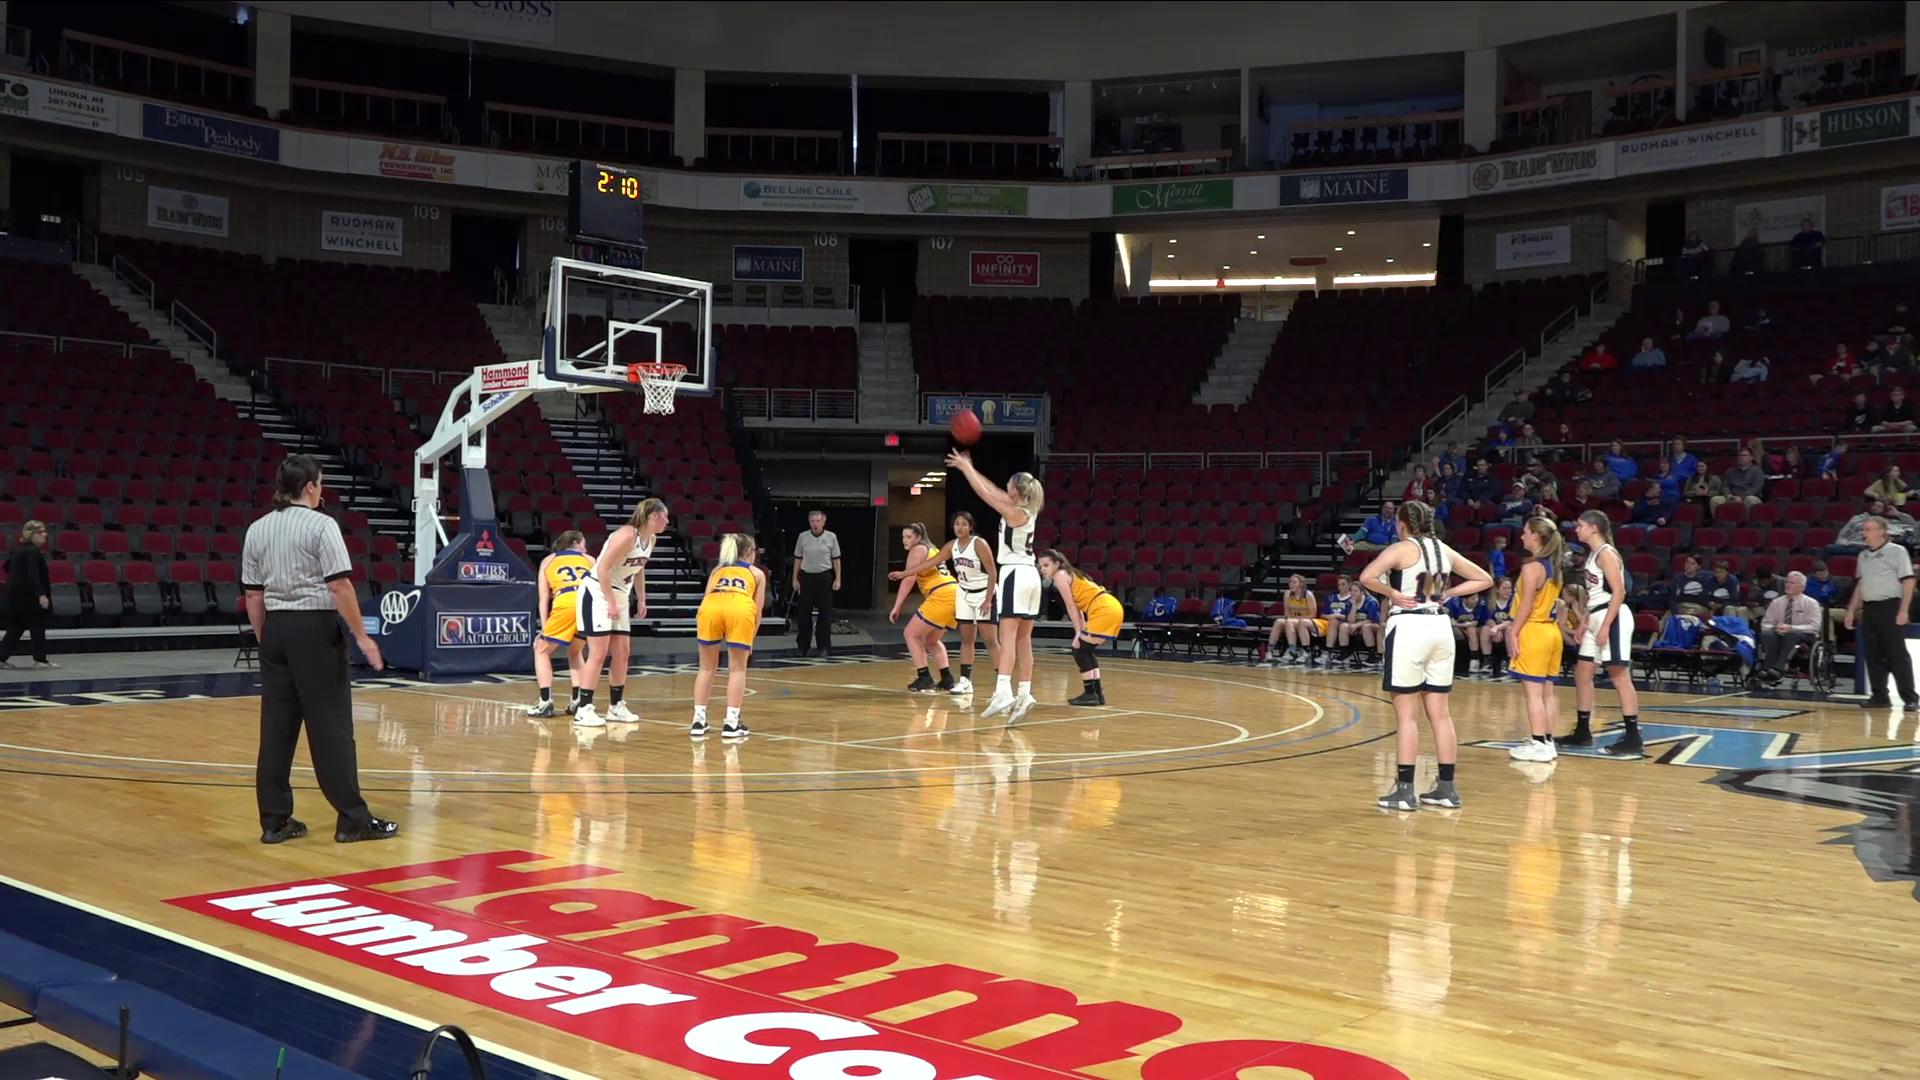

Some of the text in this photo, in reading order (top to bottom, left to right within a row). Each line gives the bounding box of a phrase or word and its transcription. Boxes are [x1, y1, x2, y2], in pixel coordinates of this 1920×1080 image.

[164, 109, 205, 128] Eaton
[1827, 104, 1904, 133] HUSSON
[203, 126, 262, 156] Peabody
[1621, 127, 1757, 154] RUDMAN WINCHELL
[597, 171, 639, 200] 2:10
[763, 185, 854, 196] BEE LINE CABLE
[1323, 178, 1391, 197] MAINE
[411, 205, 440, 220] 109
[331, 216, 394, 231] RUDMAN
[540, 216, 566, 232] 108
[326, 236, 400, 252] WINCHELL
[812, 232, 838, 248] 108
[931, 236, 955, 250] 107
[752, 259, 801, 274] MAINE
[976, 263, 1033, 276] INFINITY
[481, 362, 530, 381] Hammond
[460, 563, 508, 580] QUIRK
[440, 615, 528, 645] QUIRK
[466, 632, 529, 645] AUTO GROUP
[206, 882, 697, 1016] Lumber
[684, 1011, 1010, 1080] Co
